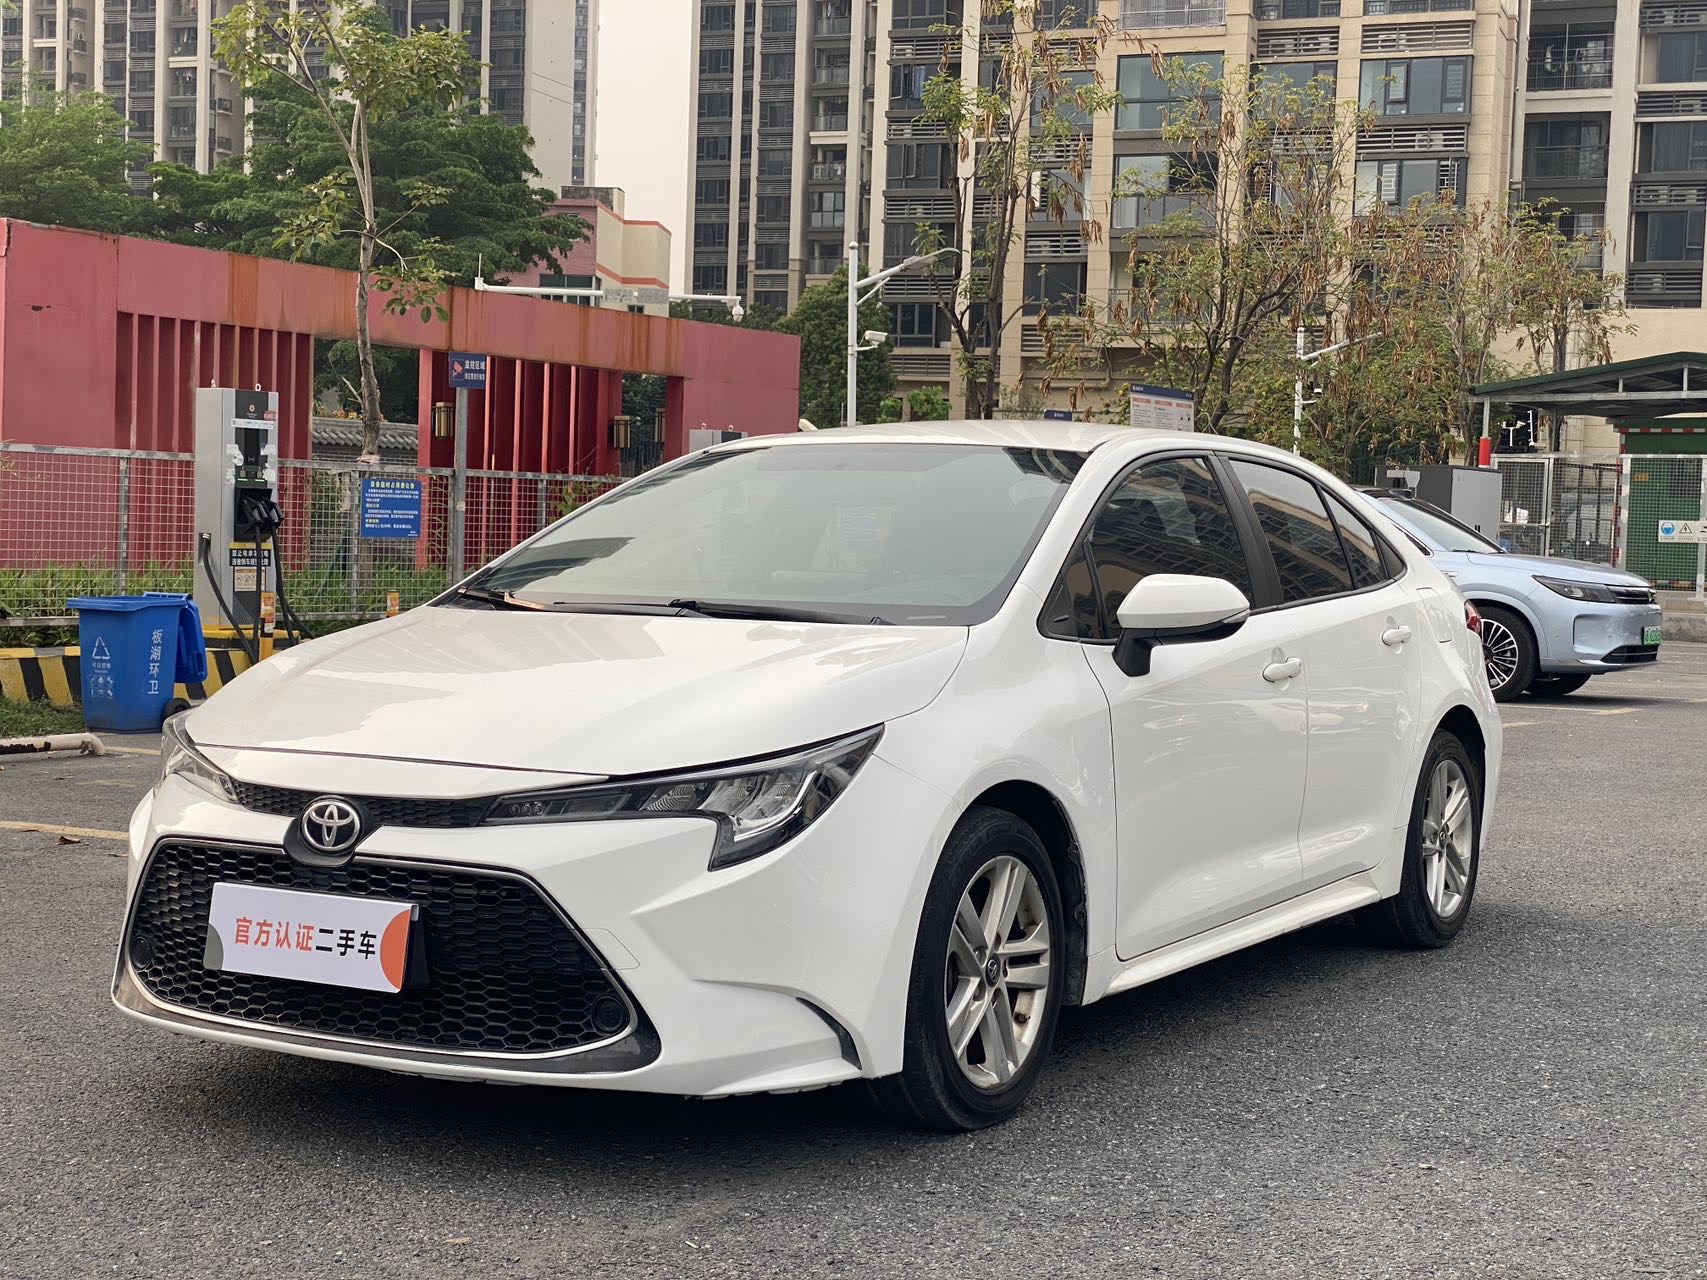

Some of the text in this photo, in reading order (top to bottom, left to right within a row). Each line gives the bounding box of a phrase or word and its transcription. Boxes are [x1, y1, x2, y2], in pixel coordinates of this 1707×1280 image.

[147, 629, 164, 694] 板湖环卫
[234, 916, 377, 960] 官方认证二手车
